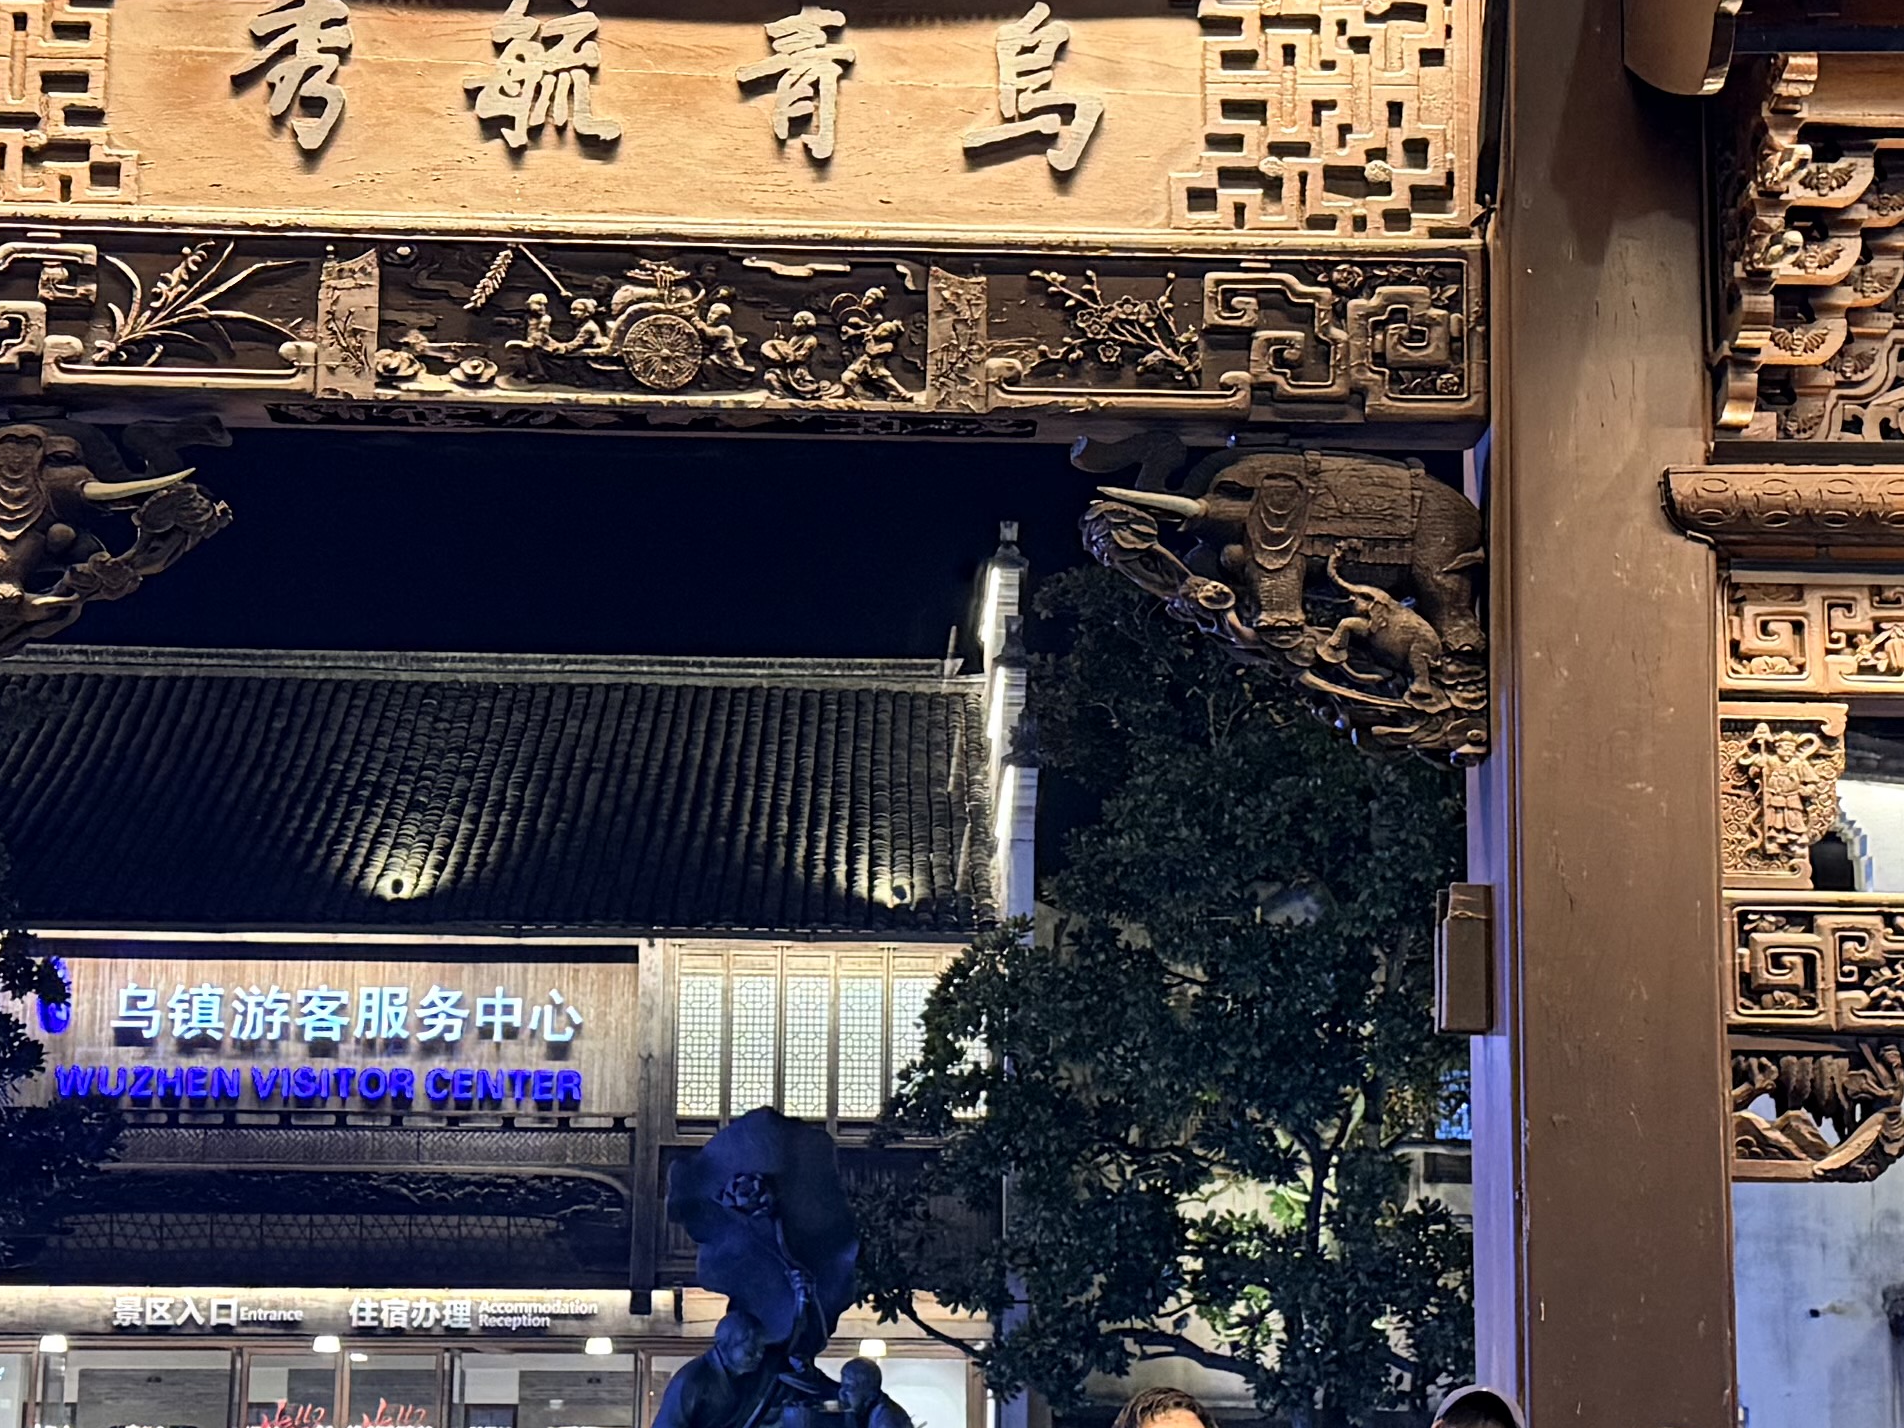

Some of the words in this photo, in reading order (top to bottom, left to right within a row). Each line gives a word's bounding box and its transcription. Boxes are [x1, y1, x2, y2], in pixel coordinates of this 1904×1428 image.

[110, 982, 584, 1043] 乌镇游客服务中心
[54, 1063, 241, 1100] WUZHEN
[251, 1066, 416, 1100] VISITOR
[424, 1067, 583, 1102] CENTER
[112, 1295, 239, 1327] 景区入口
[239, 1307, 304, 1322] Entrance
[349, 1296, 472, 1329] 住宿办理
[478, 1299, 598, 1315] Accommodation
[478, 1314, 551, 1330] Reception
